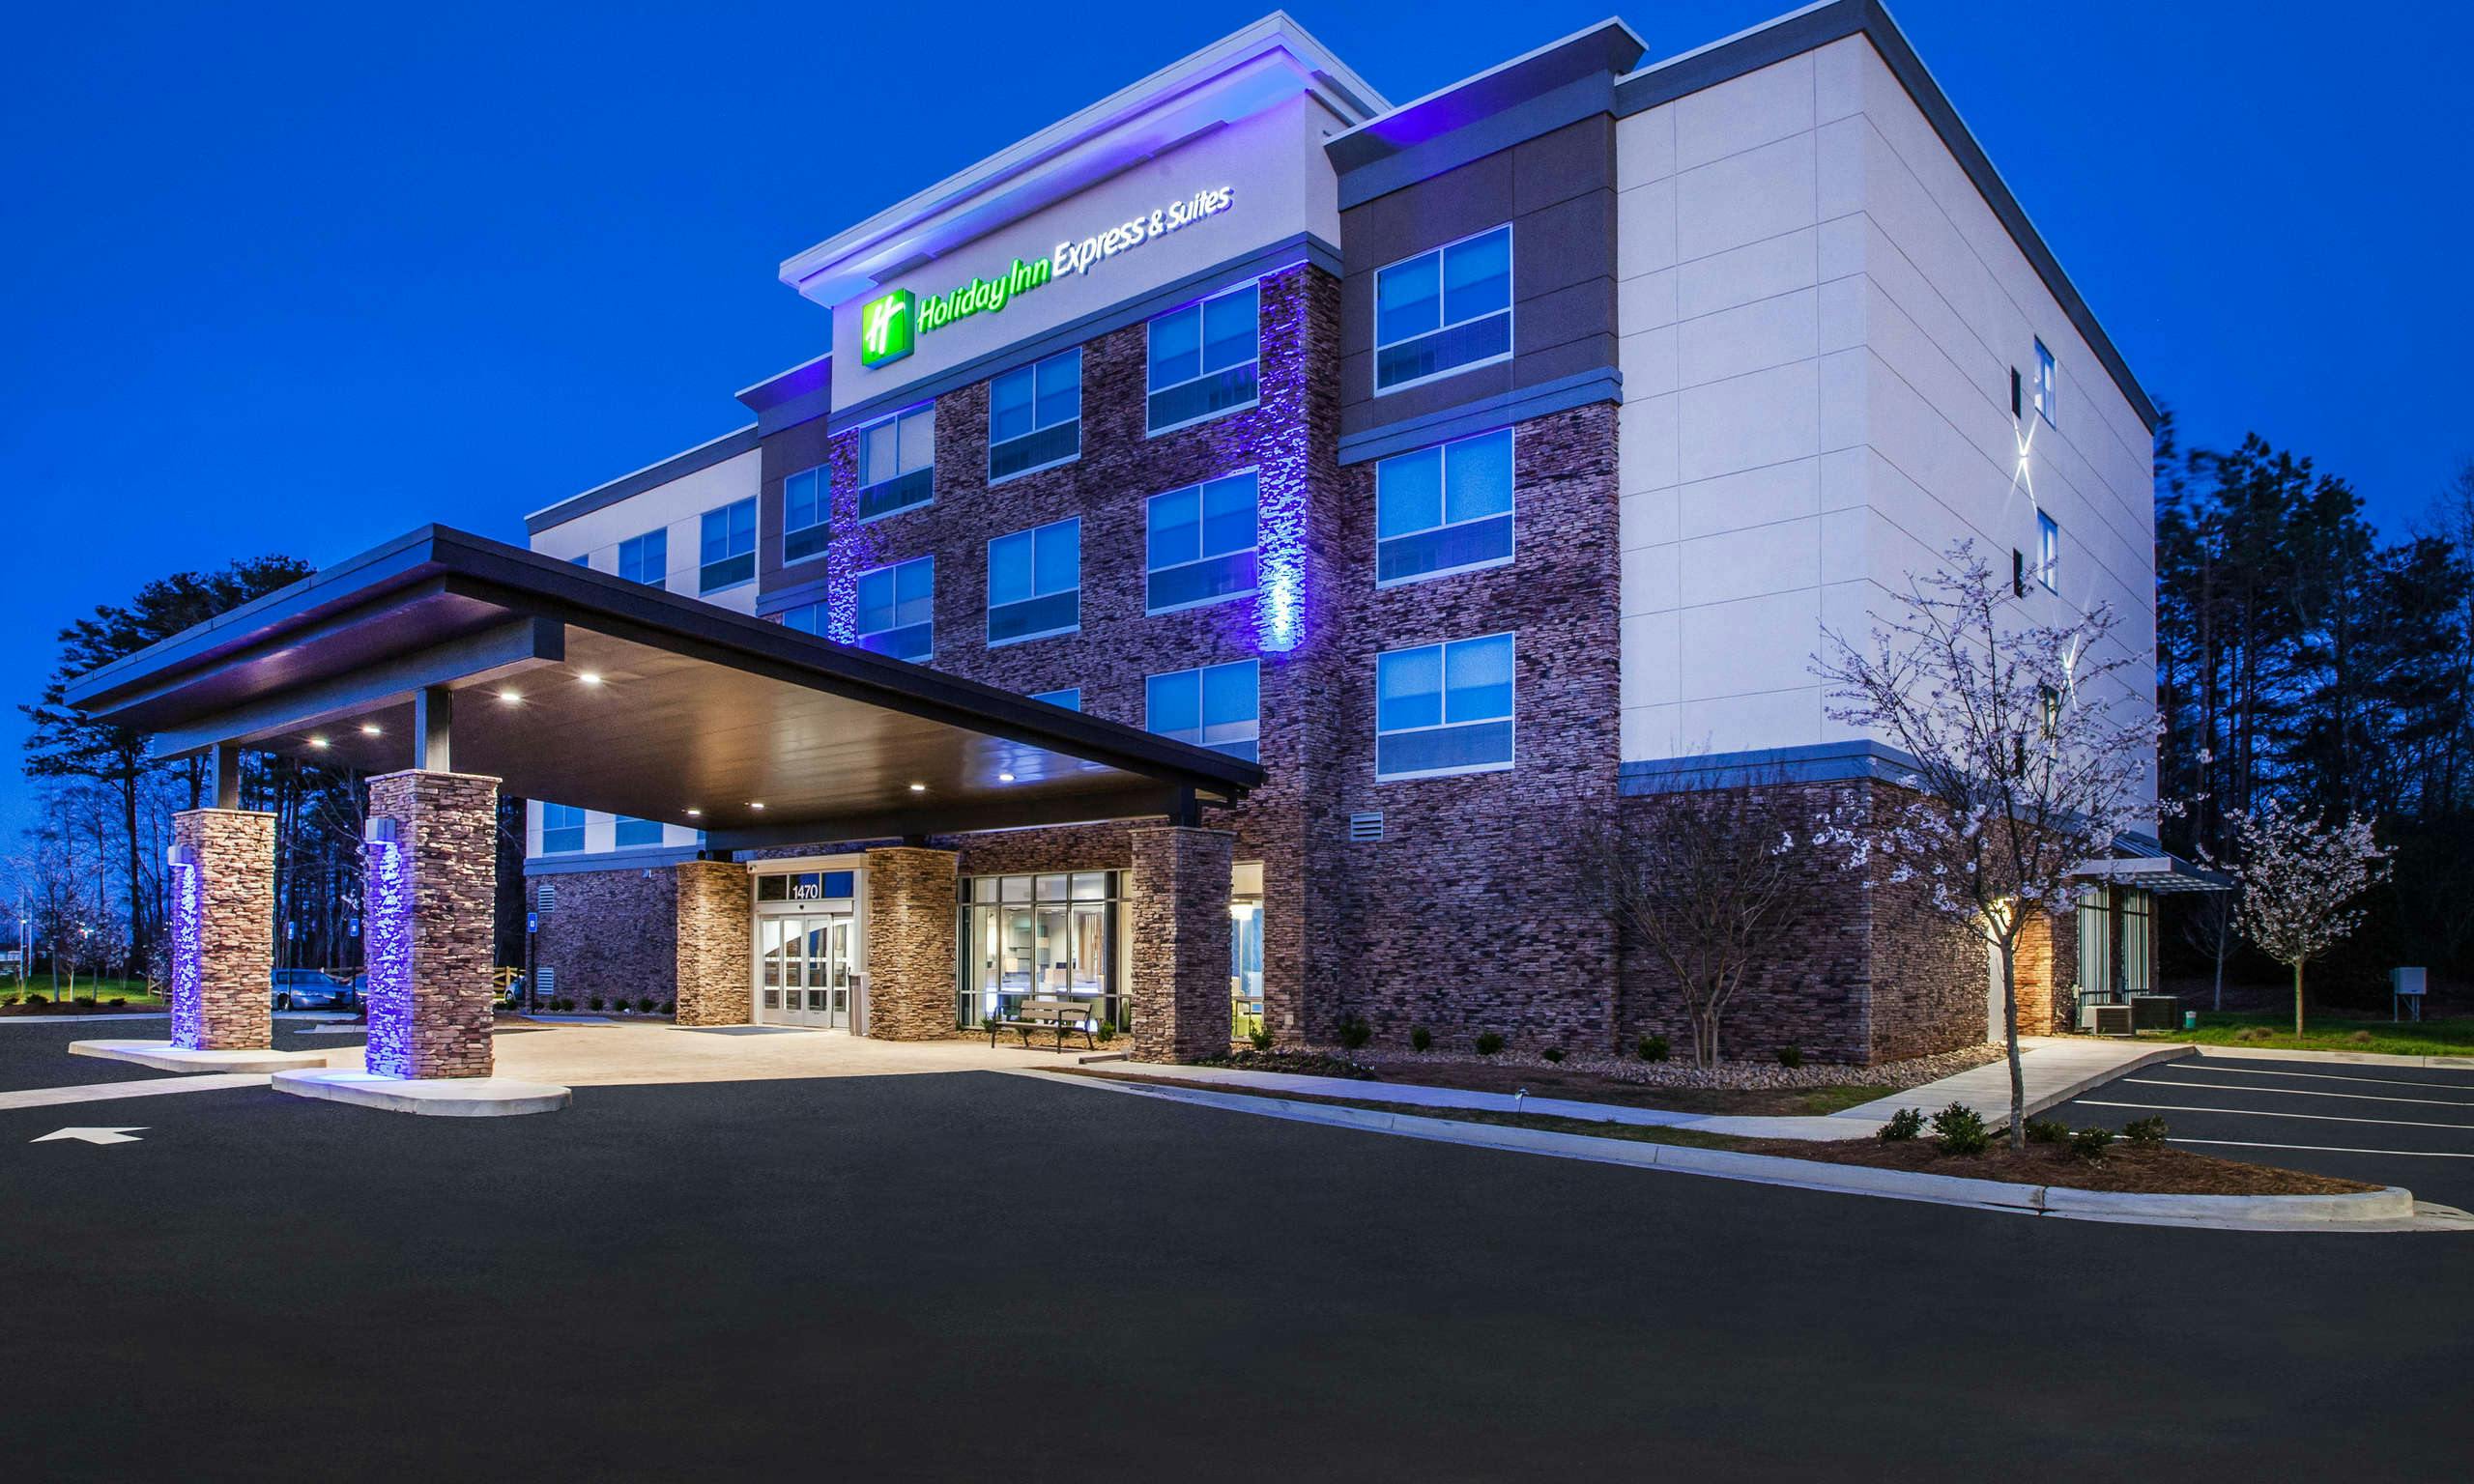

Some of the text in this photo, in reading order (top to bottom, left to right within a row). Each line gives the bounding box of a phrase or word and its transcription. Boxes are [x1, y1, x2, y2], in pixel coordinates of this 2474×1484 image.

[917, 186, 1231, 333] Holiday Inn Express & Suites
[792, 883, 819, 899] 1470
